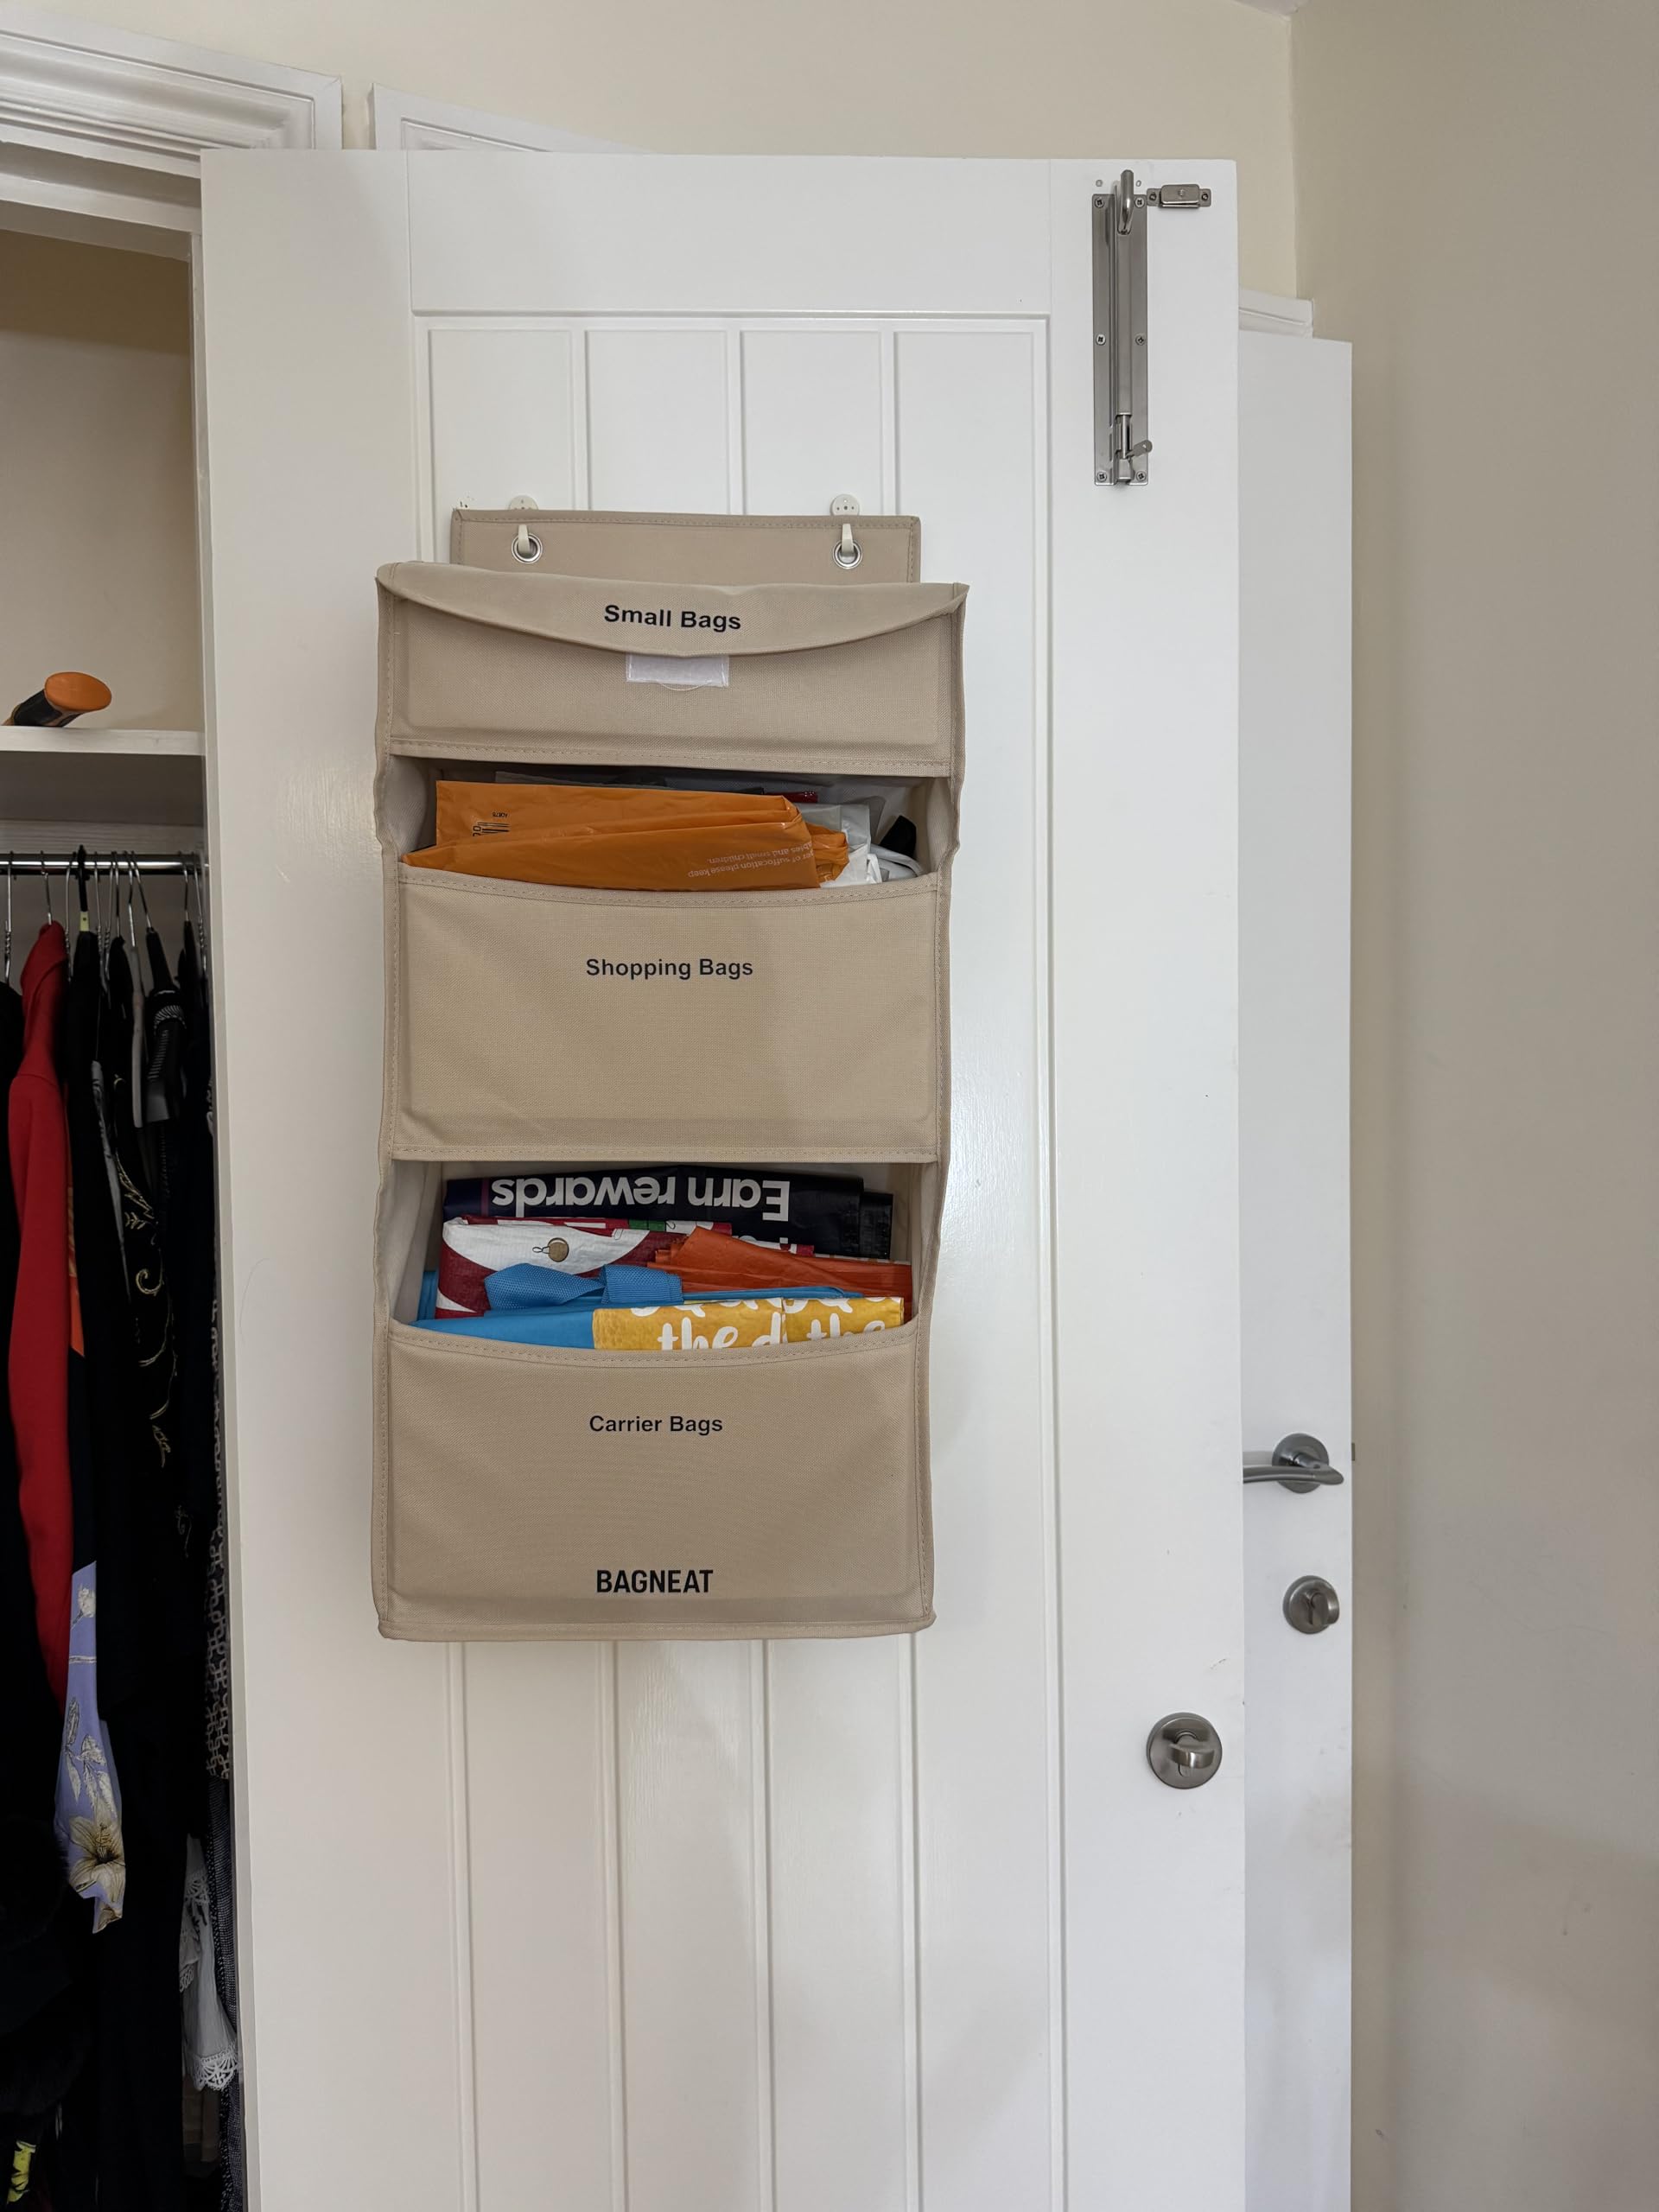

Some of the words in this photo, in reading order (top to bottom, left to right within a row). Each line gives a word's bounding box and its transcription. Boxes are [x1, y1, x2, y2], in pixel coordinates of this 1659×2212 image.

[604, 604, 672, 627] Small
[680, 610, 741, 633] Bags
[740, 856, 791, 870] suffocation
[746, 851, 771, 861] small
[688, 868, 711, 878] keep
[710, 864, 739, 874] please
[586, 958, 691, 981] Shopping
[699, 958, 753, 981] Bags
[491, 1176, 676, 1218] rewards
[687, 1179, 791, 1222] Earn
[589, 1414, 663, 1433] Carrier
[670, 1415, 723, 1436] Bags
[596, 1569, 714, 1594] BAGNEAT
